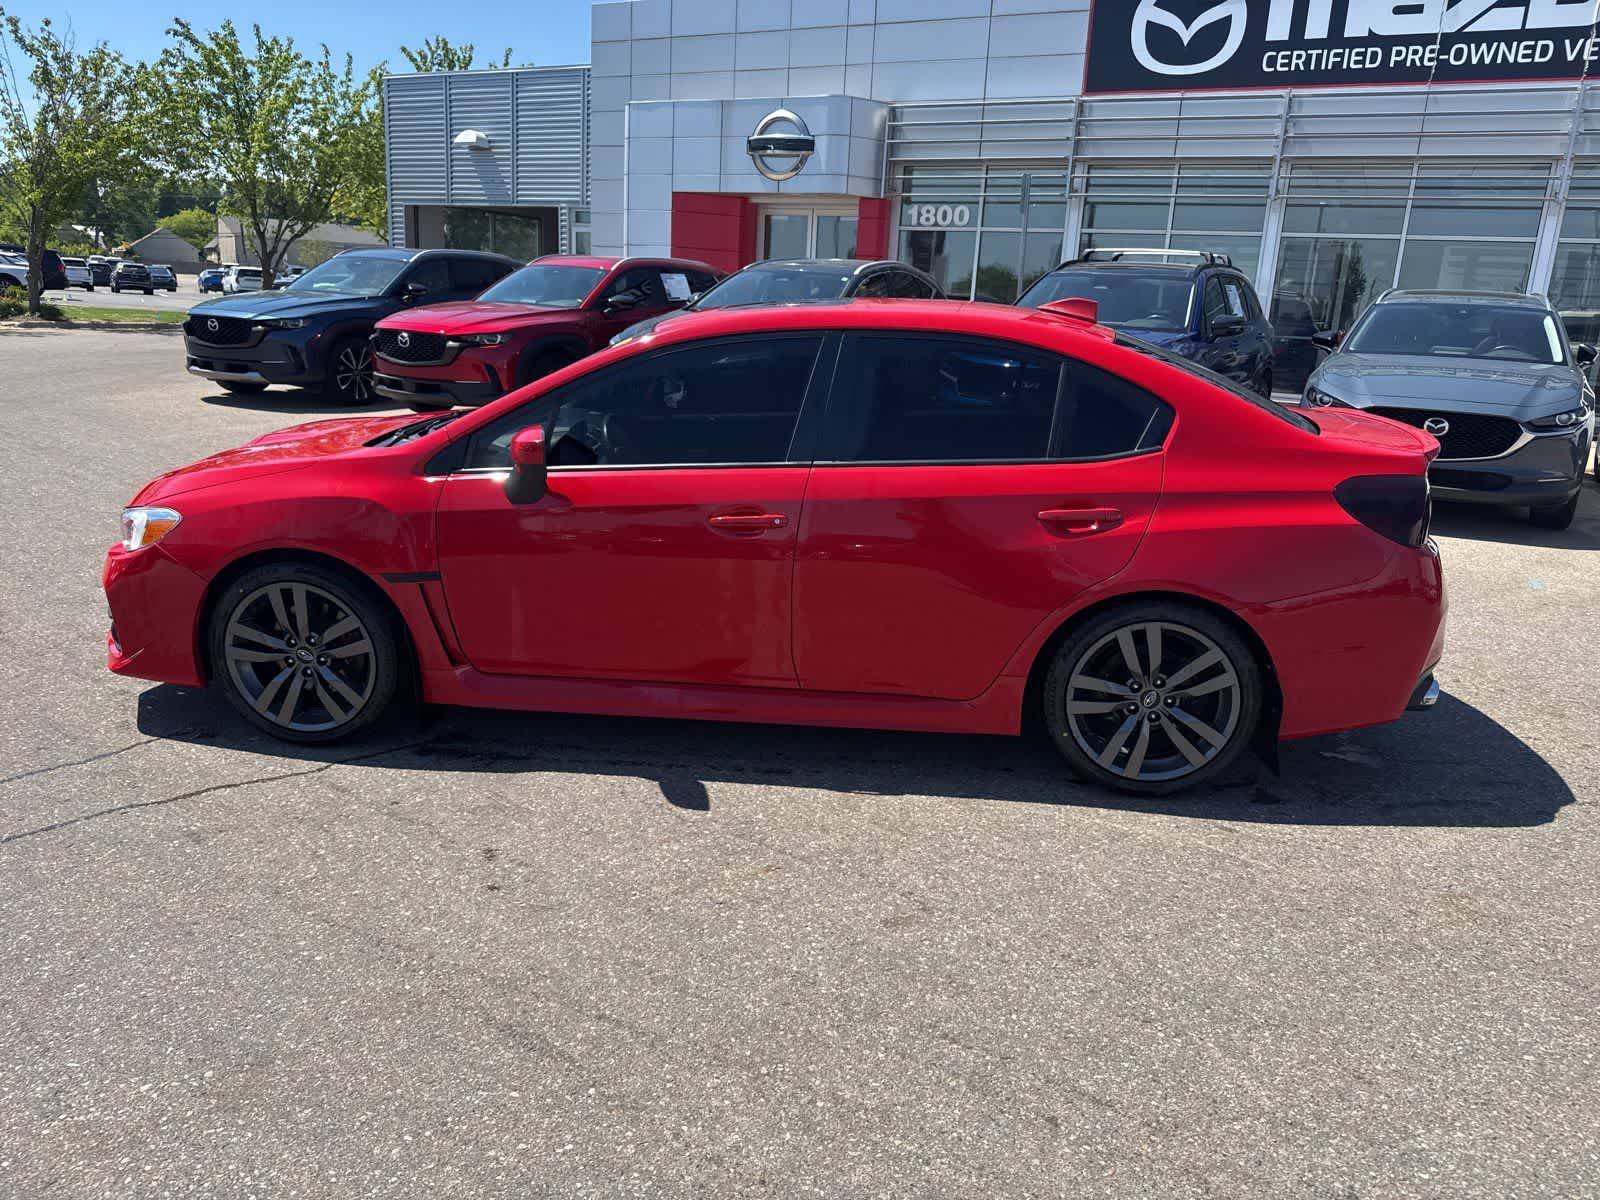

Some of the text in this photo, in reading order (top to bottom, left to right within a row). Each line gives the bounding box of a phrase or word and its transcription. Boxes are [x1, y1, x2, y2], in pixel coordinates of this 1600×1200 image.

[1262, 47, 1383, 72] CERTIFIED
[1389, 39, 1554, 68] PRE-OWNED
[908, 204, 970, 227] 1800
